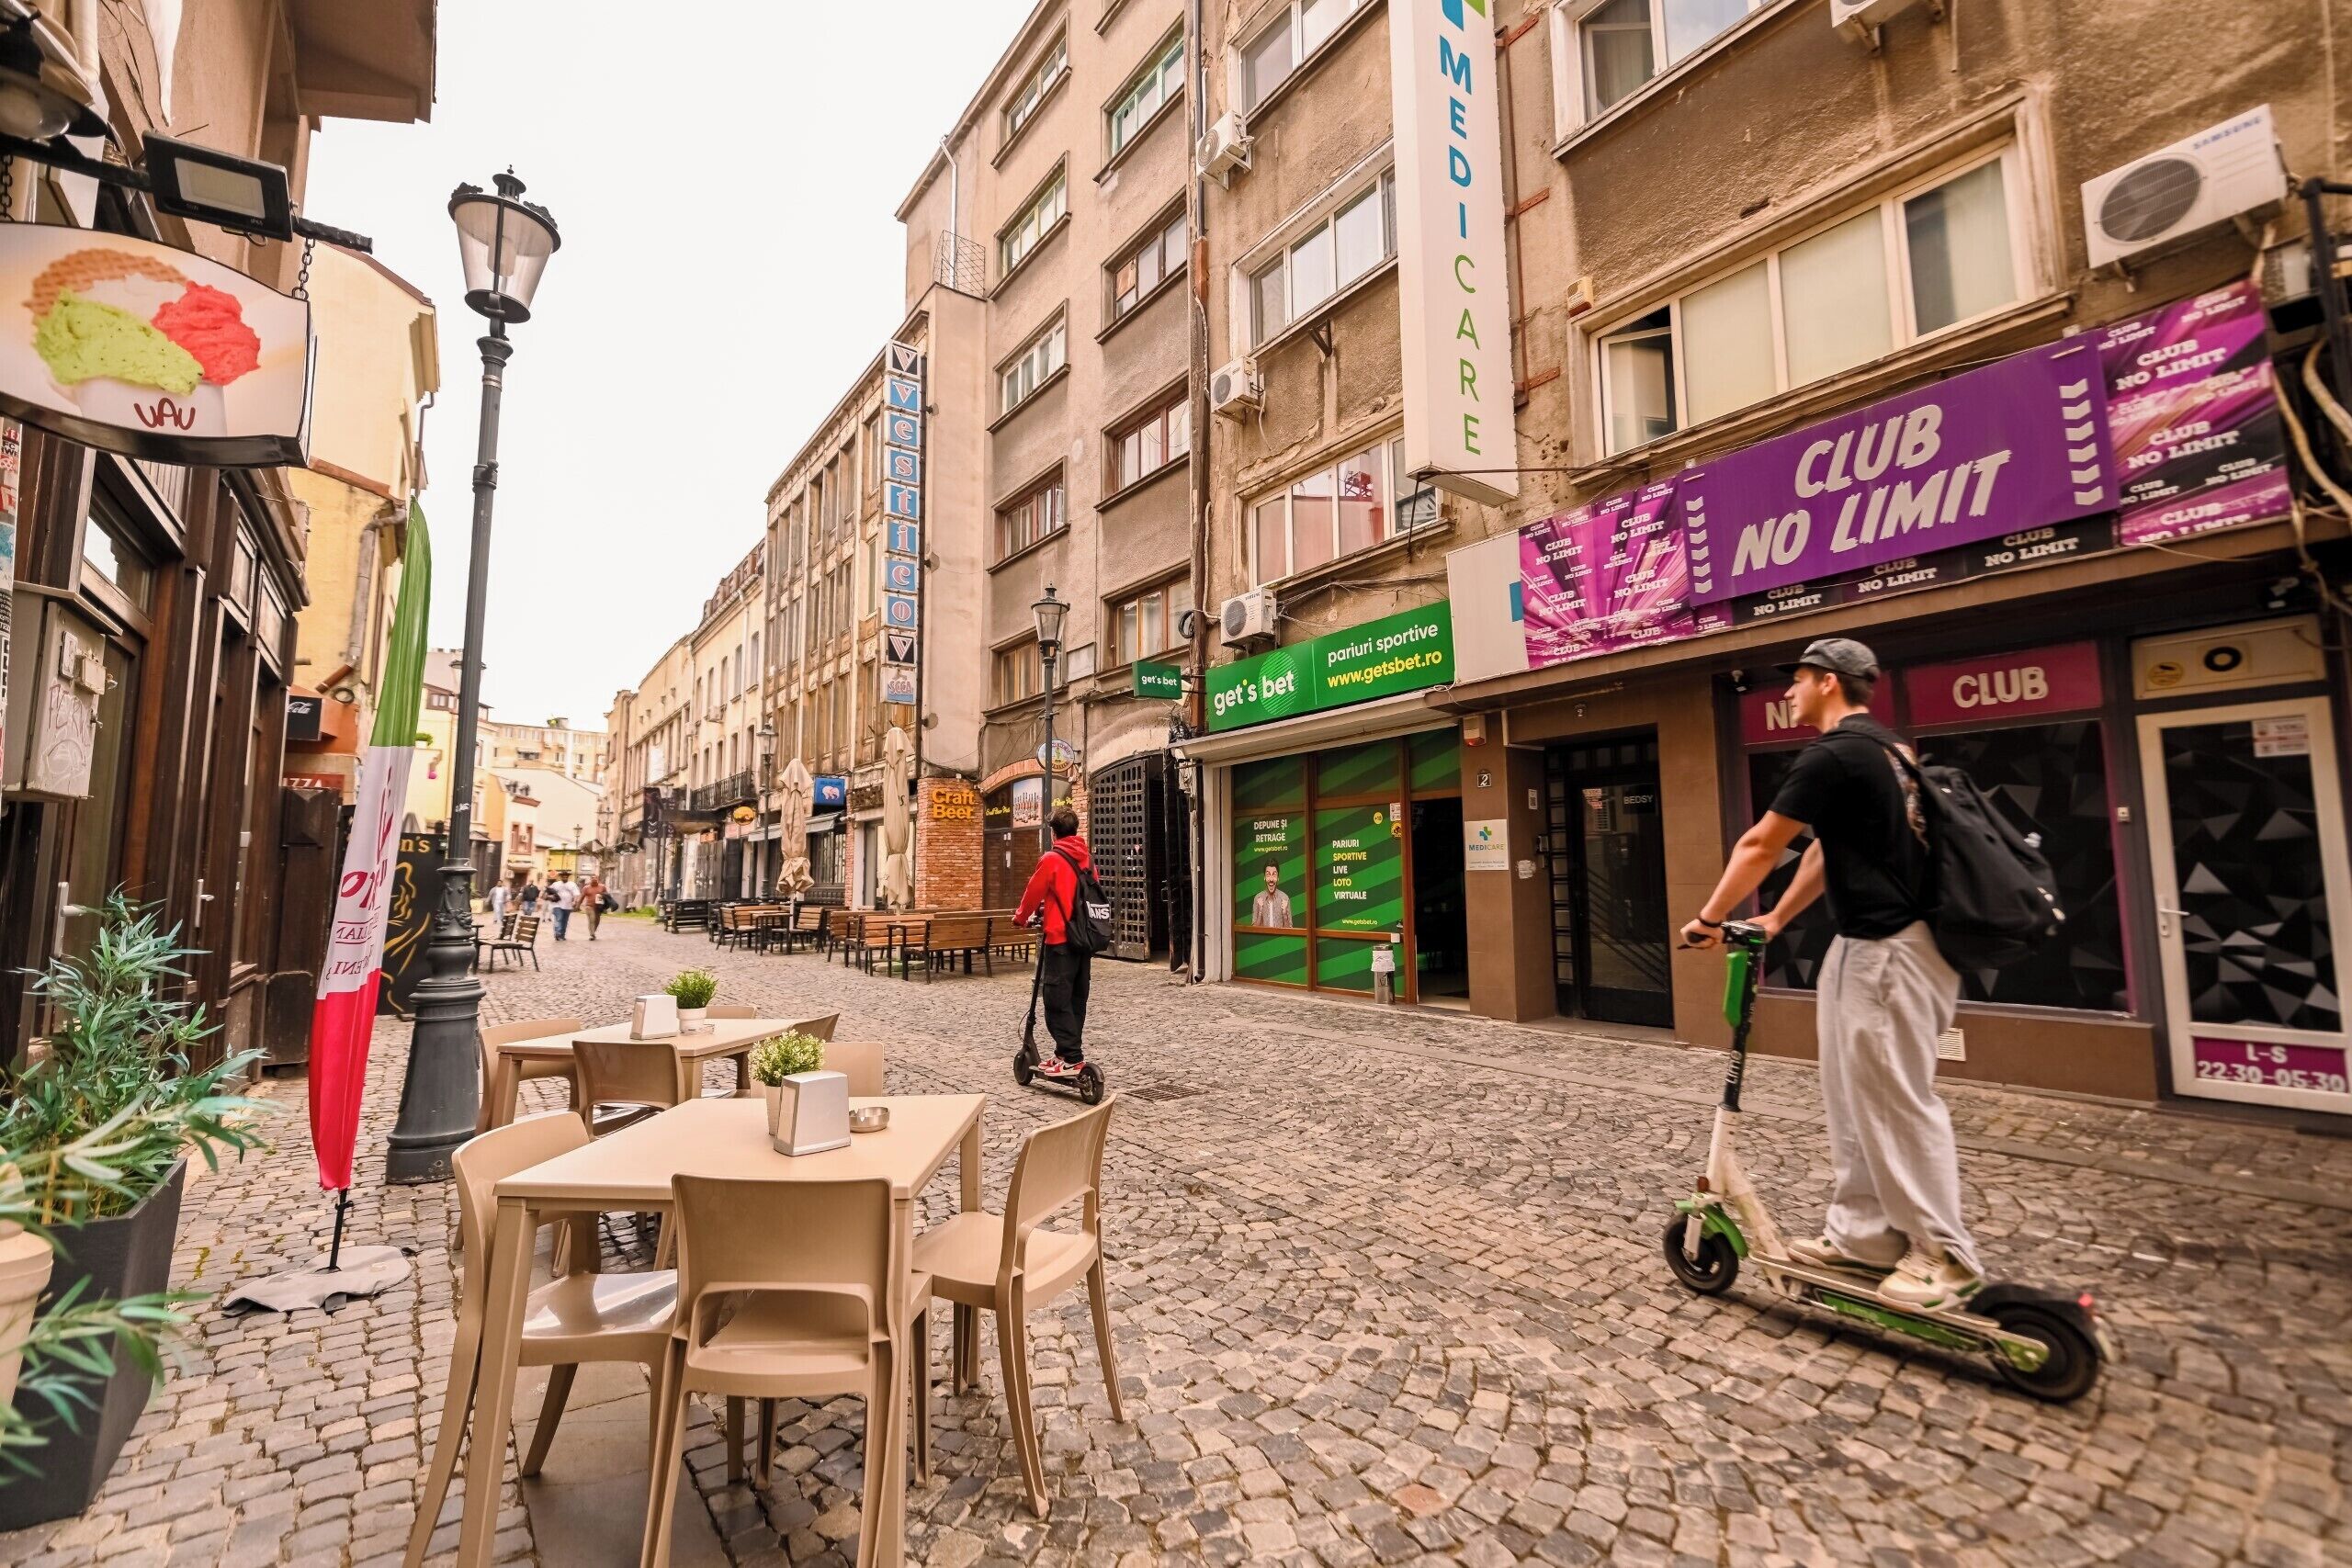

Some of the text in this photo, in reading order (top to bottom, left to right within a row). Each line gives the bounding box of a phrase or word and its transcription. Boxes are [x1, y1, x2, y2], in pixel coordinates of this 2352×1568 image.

[2194, 117, 2262, 150] SAMSUNG
[1439, 34, 1481, 456] MEDICARE
[2136, 339, 2199, 366] CLUB
[2116, 347, 2227, 390] NO LIMIT
[2149, 421, 2211, 446] CLUB
[1795, 404, 1942, 498] CLUB
[2128, 431, 2240, 468] NO LIMIT
[2120, 485, 2180, 505] NO LIMIT
[2130, 480, 2164, 493] CLUB
[1622, 513, 1651, 528] CLUB
[1732, 450, 2012, 576] NO LIMIT
[2159, 502, 2222, 525] CLUB
[1611, 521, 1665, 544] NO LIMIT
[2003, 528, 2055, 547] CLUB
[1545, 537, 1571, 551] CLUB
[1984, 537, 2079, 567] NO LIMIT
[1536, 546, 1583, 565] NO LIMIT
[1872, 558, 1917, 576] CLUB
[1625, 570, 1655, 583] CLUB
[1858, 568, 1937, 592] NO LIMIT
[1614, 578, 1668, 598] NO LIMIT
[1768, 585, 1804, 600] CLUB
[1548, 591, 1574, 604] CLUB
[1754, 593, 1821, 616] NO LIMIT
[1539, 599, 1586, 616] NO LIMIT
[1631, 627, 1661, 639] CLUB
[1703, 621, 1726, 631] LIMIT
[1328, 624, 1438, 667] pariuri sportive
[1553, 644, 1580, 655] CLUB
[1328, 650, 1442, 688] www.getsbet.ro
[1142, 675, 1177, 685] get's bet
[1952, 667, 2049, 708] CLUB
[1215, 671, 1295, 716] get's bet
[282, 778, 322, 788] IZZA
[1480, 774, 1488, 786] 2
[933, 788, 974, 805] Craft
[933, 804, 974, 819] Beer
[1254, 820, 1279, 829] DEPUNE
[1256, 833, 1285, 842] RETRAGE
[1332, 840, 1359, 848] PARIURI
[1333, 852, 1366, 861] SPORTIVE
[1333, 865, 1348, 874] LIVE
[1333, 878, 1351, 886] LOTO
[1334, 891, 1366, 899] VIRTUALE
[1342, 918, 1377, 926] www.getsbet.ro
